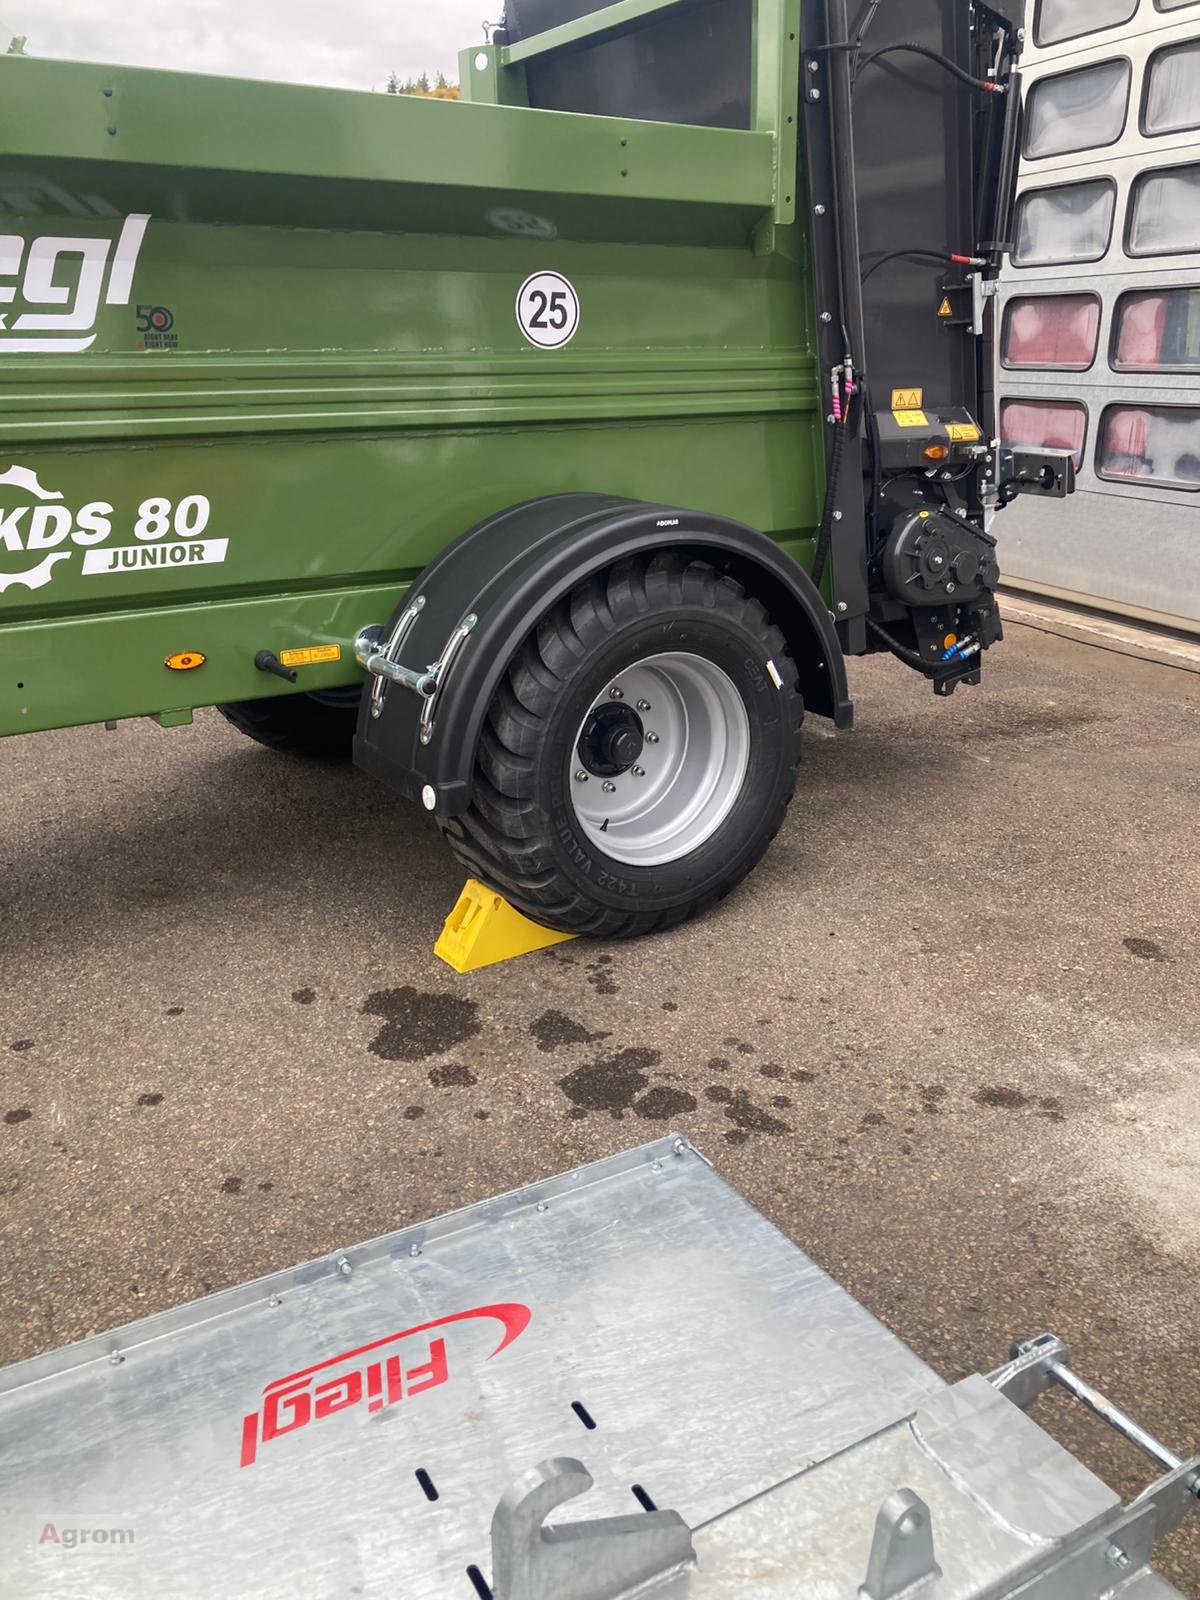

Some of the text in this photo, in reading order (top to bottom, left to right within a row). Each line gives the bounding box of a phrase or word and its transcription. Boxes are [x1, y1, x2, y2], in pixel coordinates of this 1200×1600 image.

[529, 290, 568, 329] 25
[134, 494, 210, 541] 80
[108, 543, 205, 570] JUNIOR
[597, 870, 639, 897] T422
[240, 1337, 449, 1468] Fliegl
